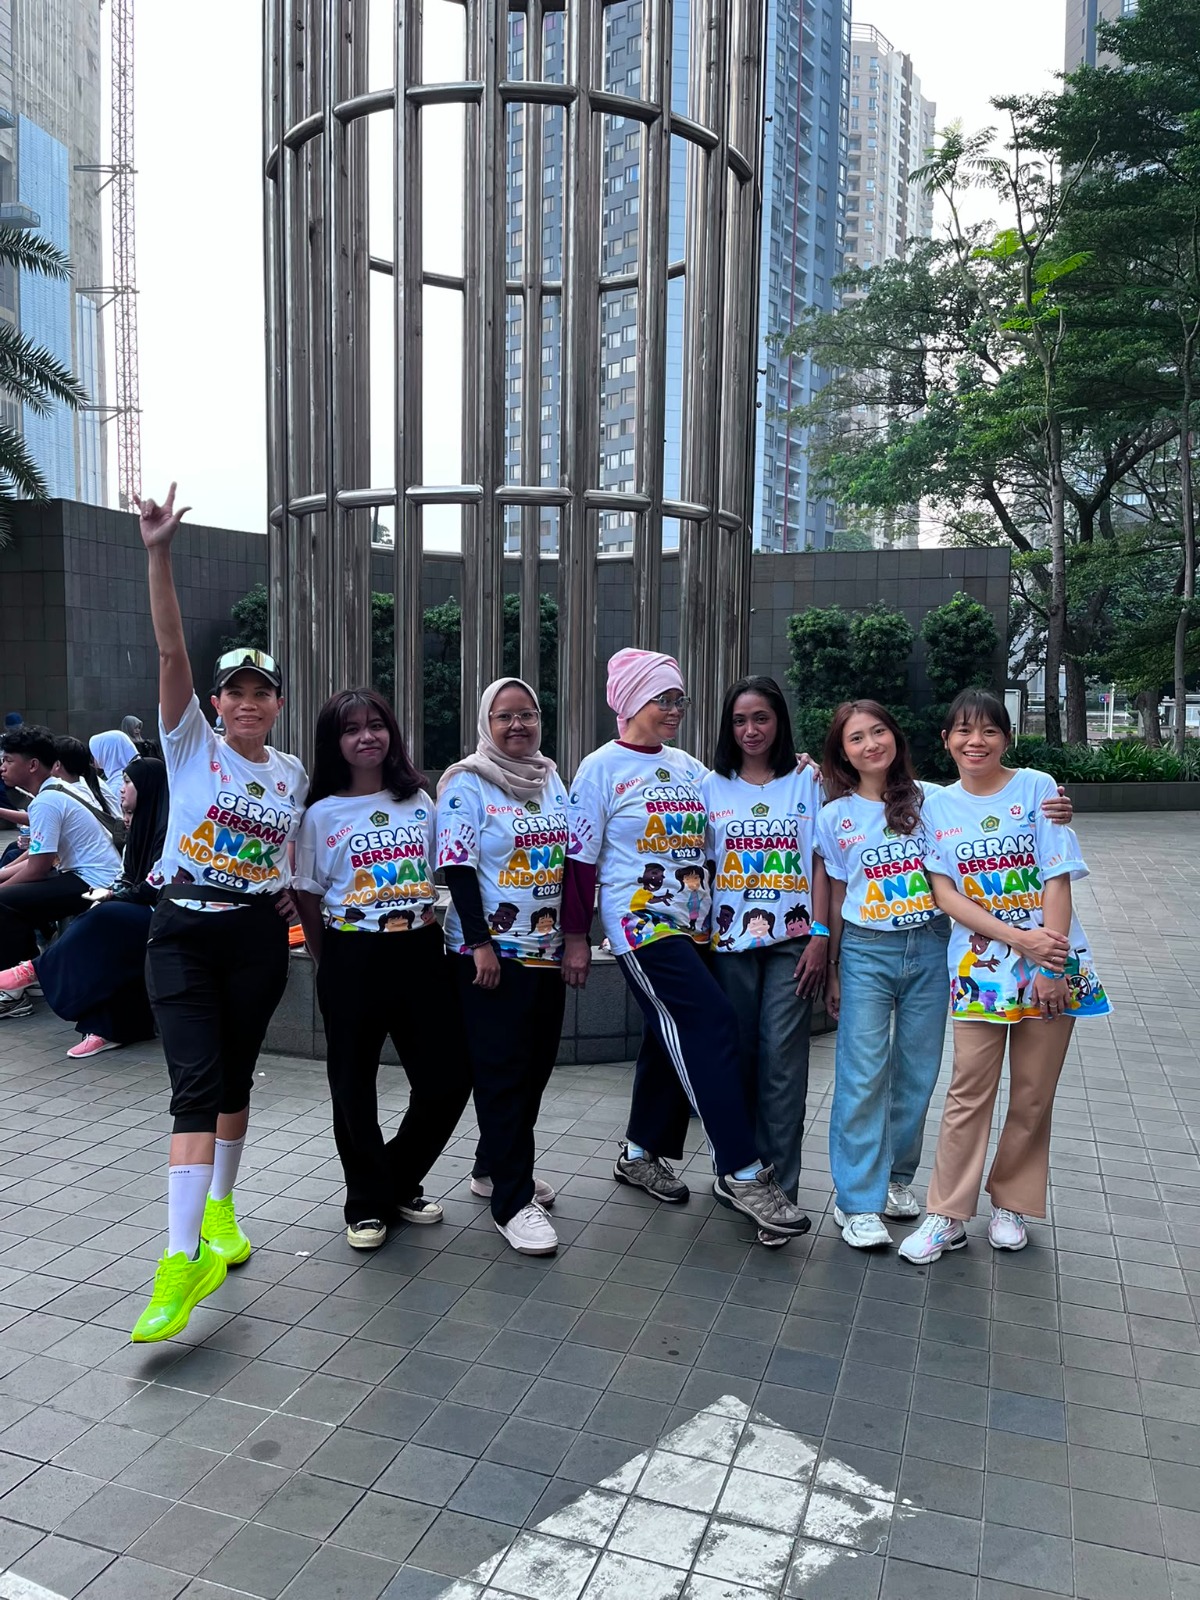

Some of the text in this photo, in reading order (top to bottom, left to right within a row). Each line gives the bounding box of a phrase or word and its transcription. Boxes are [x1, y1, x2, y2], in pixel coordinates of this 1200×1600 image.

[642, 784, 700, 801] GERAK
[216, 791, 292, 833] GERAK
[645, 801, 706, 813] BERSAMA
[715, 809, 734, 819] KPAI
[206, 805, 286, 846] BERSAMA
[512, 812, 569, 835] GERAK
[644, 812, 708, 838] ANAK
[726, 819, 799, 837] GERAK
[943, 826, 963, 838] KPAI
[192, 820, 281, 868] ANAK
[350, 825, 424, 853] GERAK
[515, 830, 568, 848] BERSAM
[725, 837, 799, 851] BERSAMA
[846, 834, 866, 846] KPAI
[956, 834, 1035, 861] GERAK
[179, 834, 281, 884] INDONESIA
[351, 844, 424, 869] BERSAMA
[508, 844, 565, 871] ANA
[674, 848, 697, 858] 2026
[723, 850, 802, 875] ANAK
[957, 853, 1036, 875] BERSAMA
[208, 869, 244, 888] 2026
[354, 858, 428, 892] ANAK
[498, 867, 564, 887] INDONE
[716, 873, 809, 891] INDONESIA
[963, 866, 1043, 898] ANAK
[537, 884, 560, 896] 2026
[747, 890, 776, 899] 2026
[865, 872, 930, 904] ANA
[860, 895, 934, 920] INDONE
[896, 912, 931, 926] 2026
